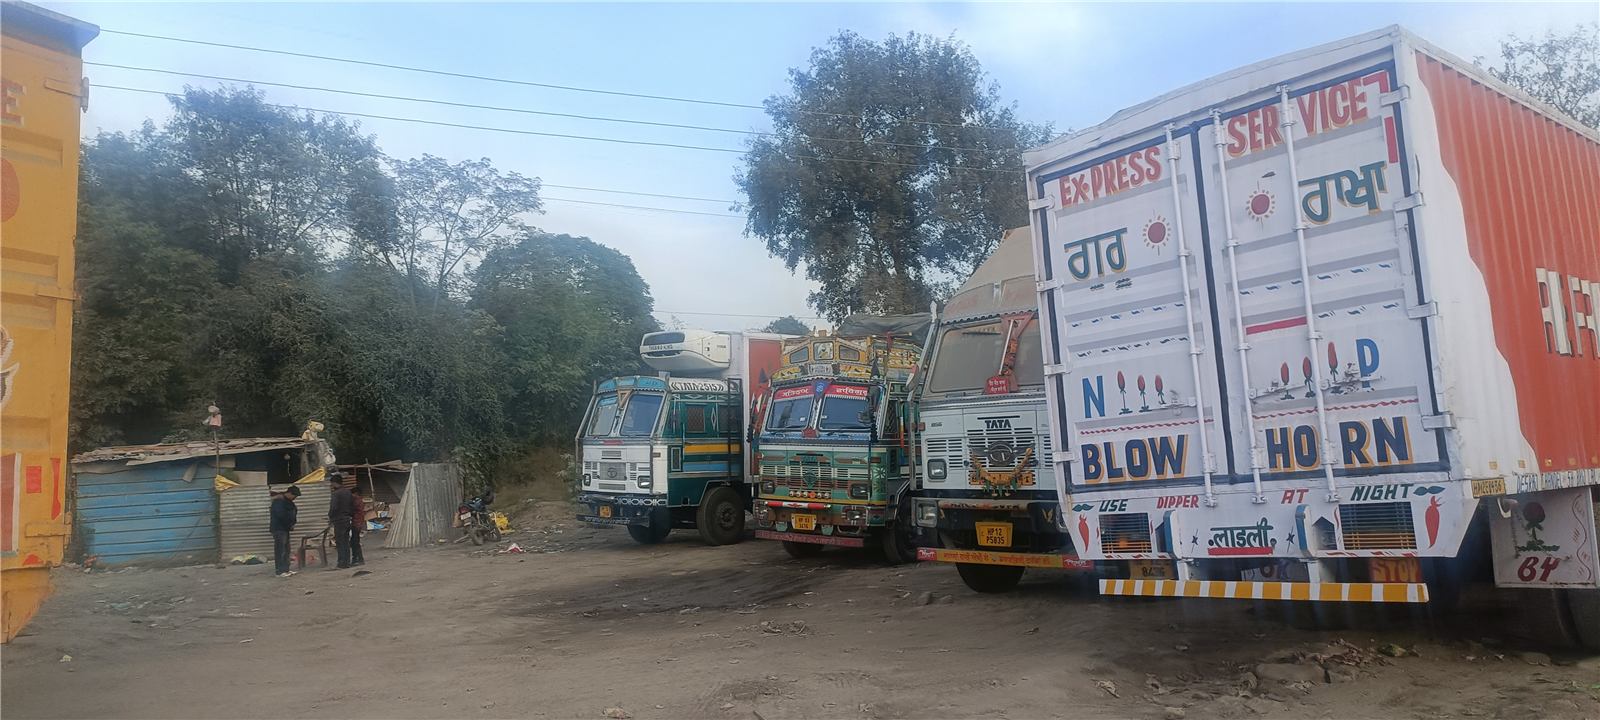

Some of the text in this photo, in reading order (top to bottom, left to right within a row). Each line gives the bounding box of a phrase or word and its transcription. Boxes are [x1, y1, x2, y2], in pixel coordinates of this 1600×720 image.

[1060, 78, 1368, 208] EXPRESS SERVICE
[1082, 338, 1380, 418] N P
[985, 419, 1011, 428] TATA
[1081, 416, 1414, 484] BLOW HORN
[1098, 483, 1415, 512] USE DIPPER AT NIGHT
